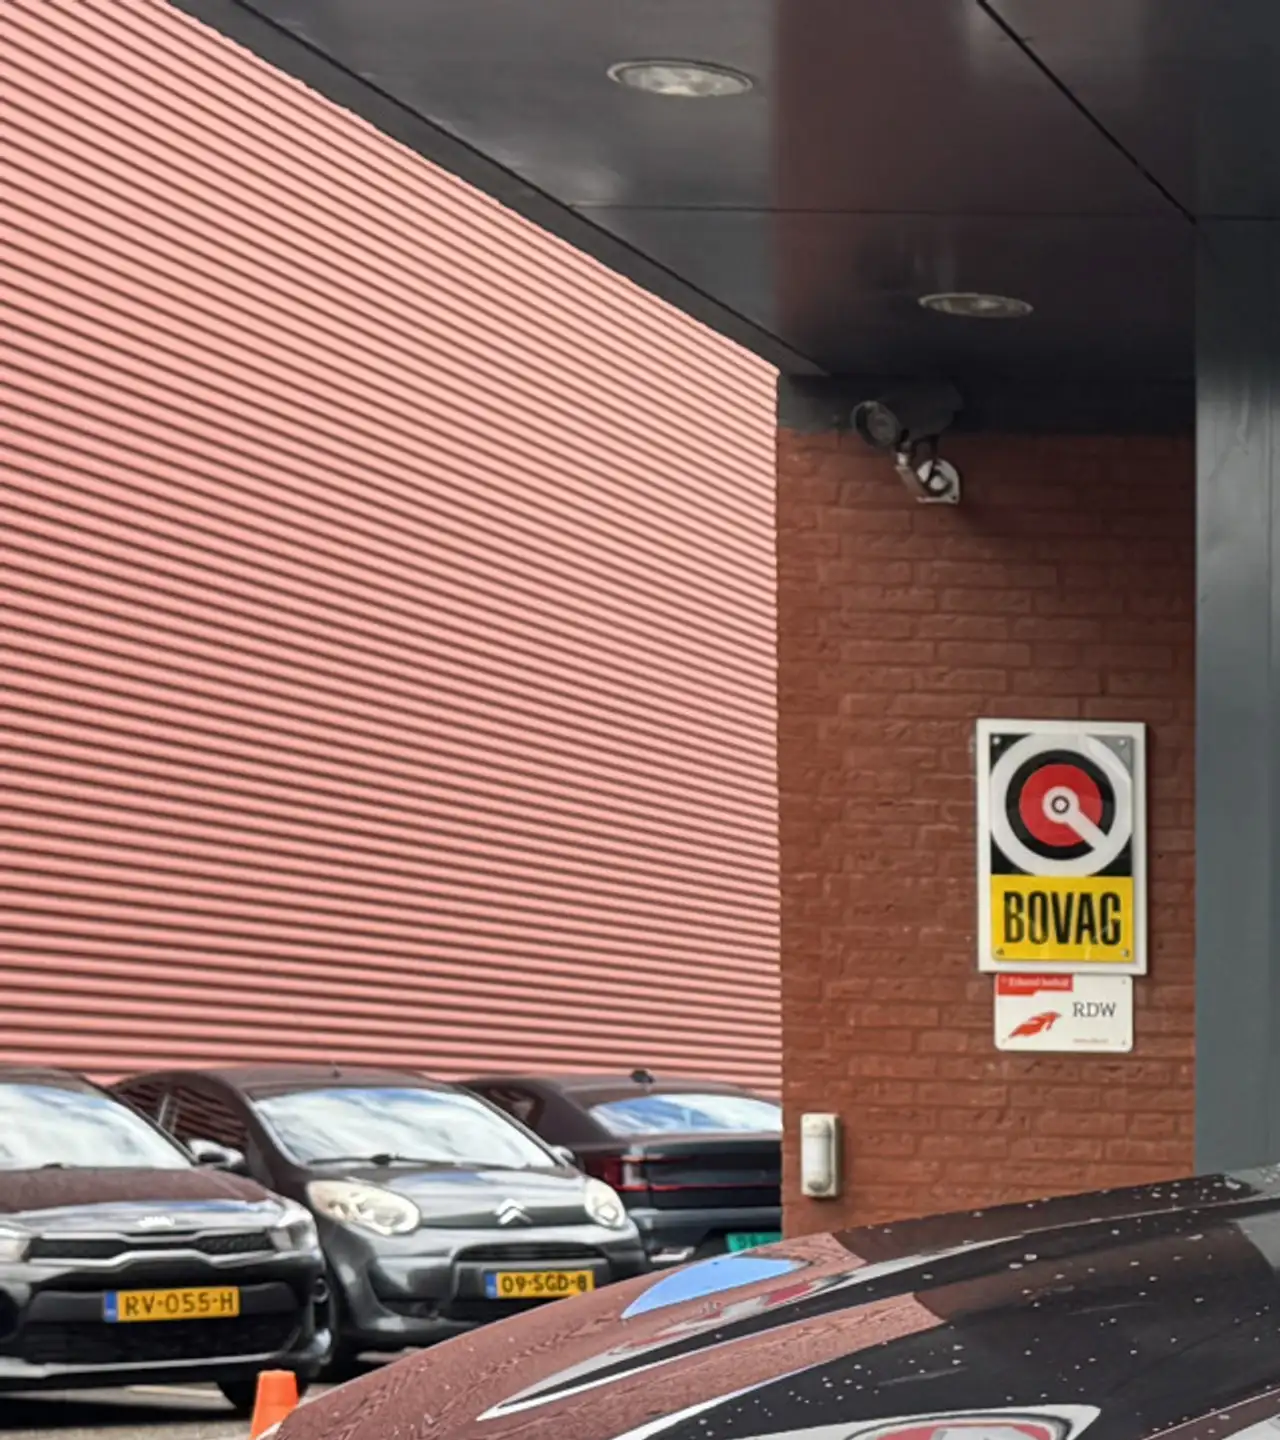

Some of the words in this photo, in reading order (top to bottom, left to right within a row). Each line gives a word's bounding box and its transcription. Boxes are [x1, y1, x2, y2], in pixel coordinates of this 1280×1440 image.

[1003, 891, 1122, 945] BOVAG
[1072, 1002, 1116, 1017] RDW
[125, 1292, 233, 1316] RV-055-H
